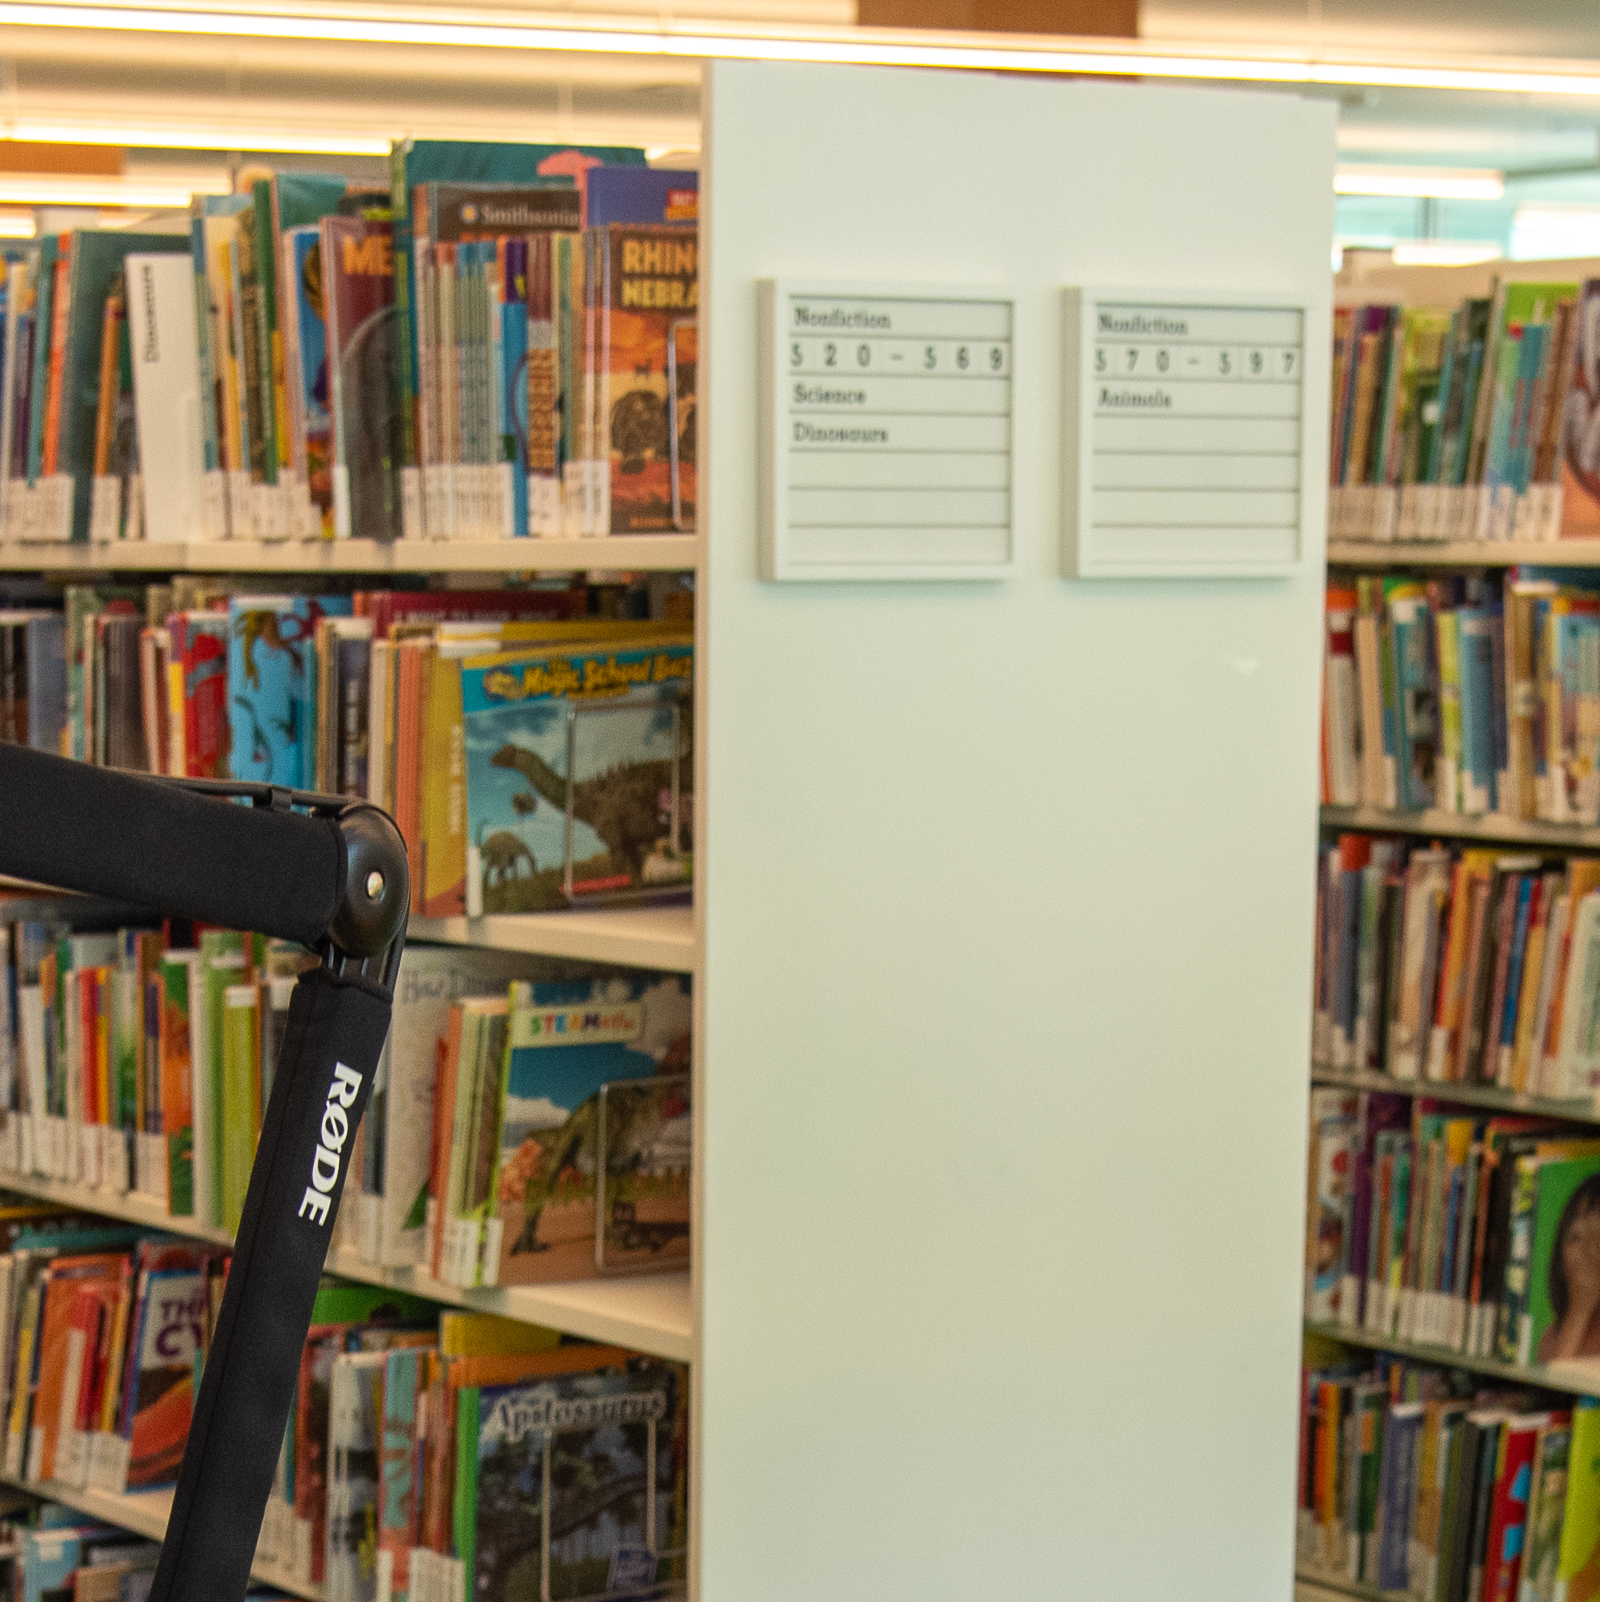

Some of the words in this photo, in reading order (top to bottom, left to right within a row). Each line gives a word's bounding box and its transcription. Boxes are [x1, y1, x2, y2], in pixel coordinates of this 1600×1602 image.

[793, 306, 891, 331] Nonfiction
[1098, 312, 1189, 336] Nonfiction
[793, 383, 866, 406] Science
[1099, 387, 1173, 409] Animals
[793, 421, 889, 444] Dinosaurs
[298, 1060, 364, 1227] RØDE
